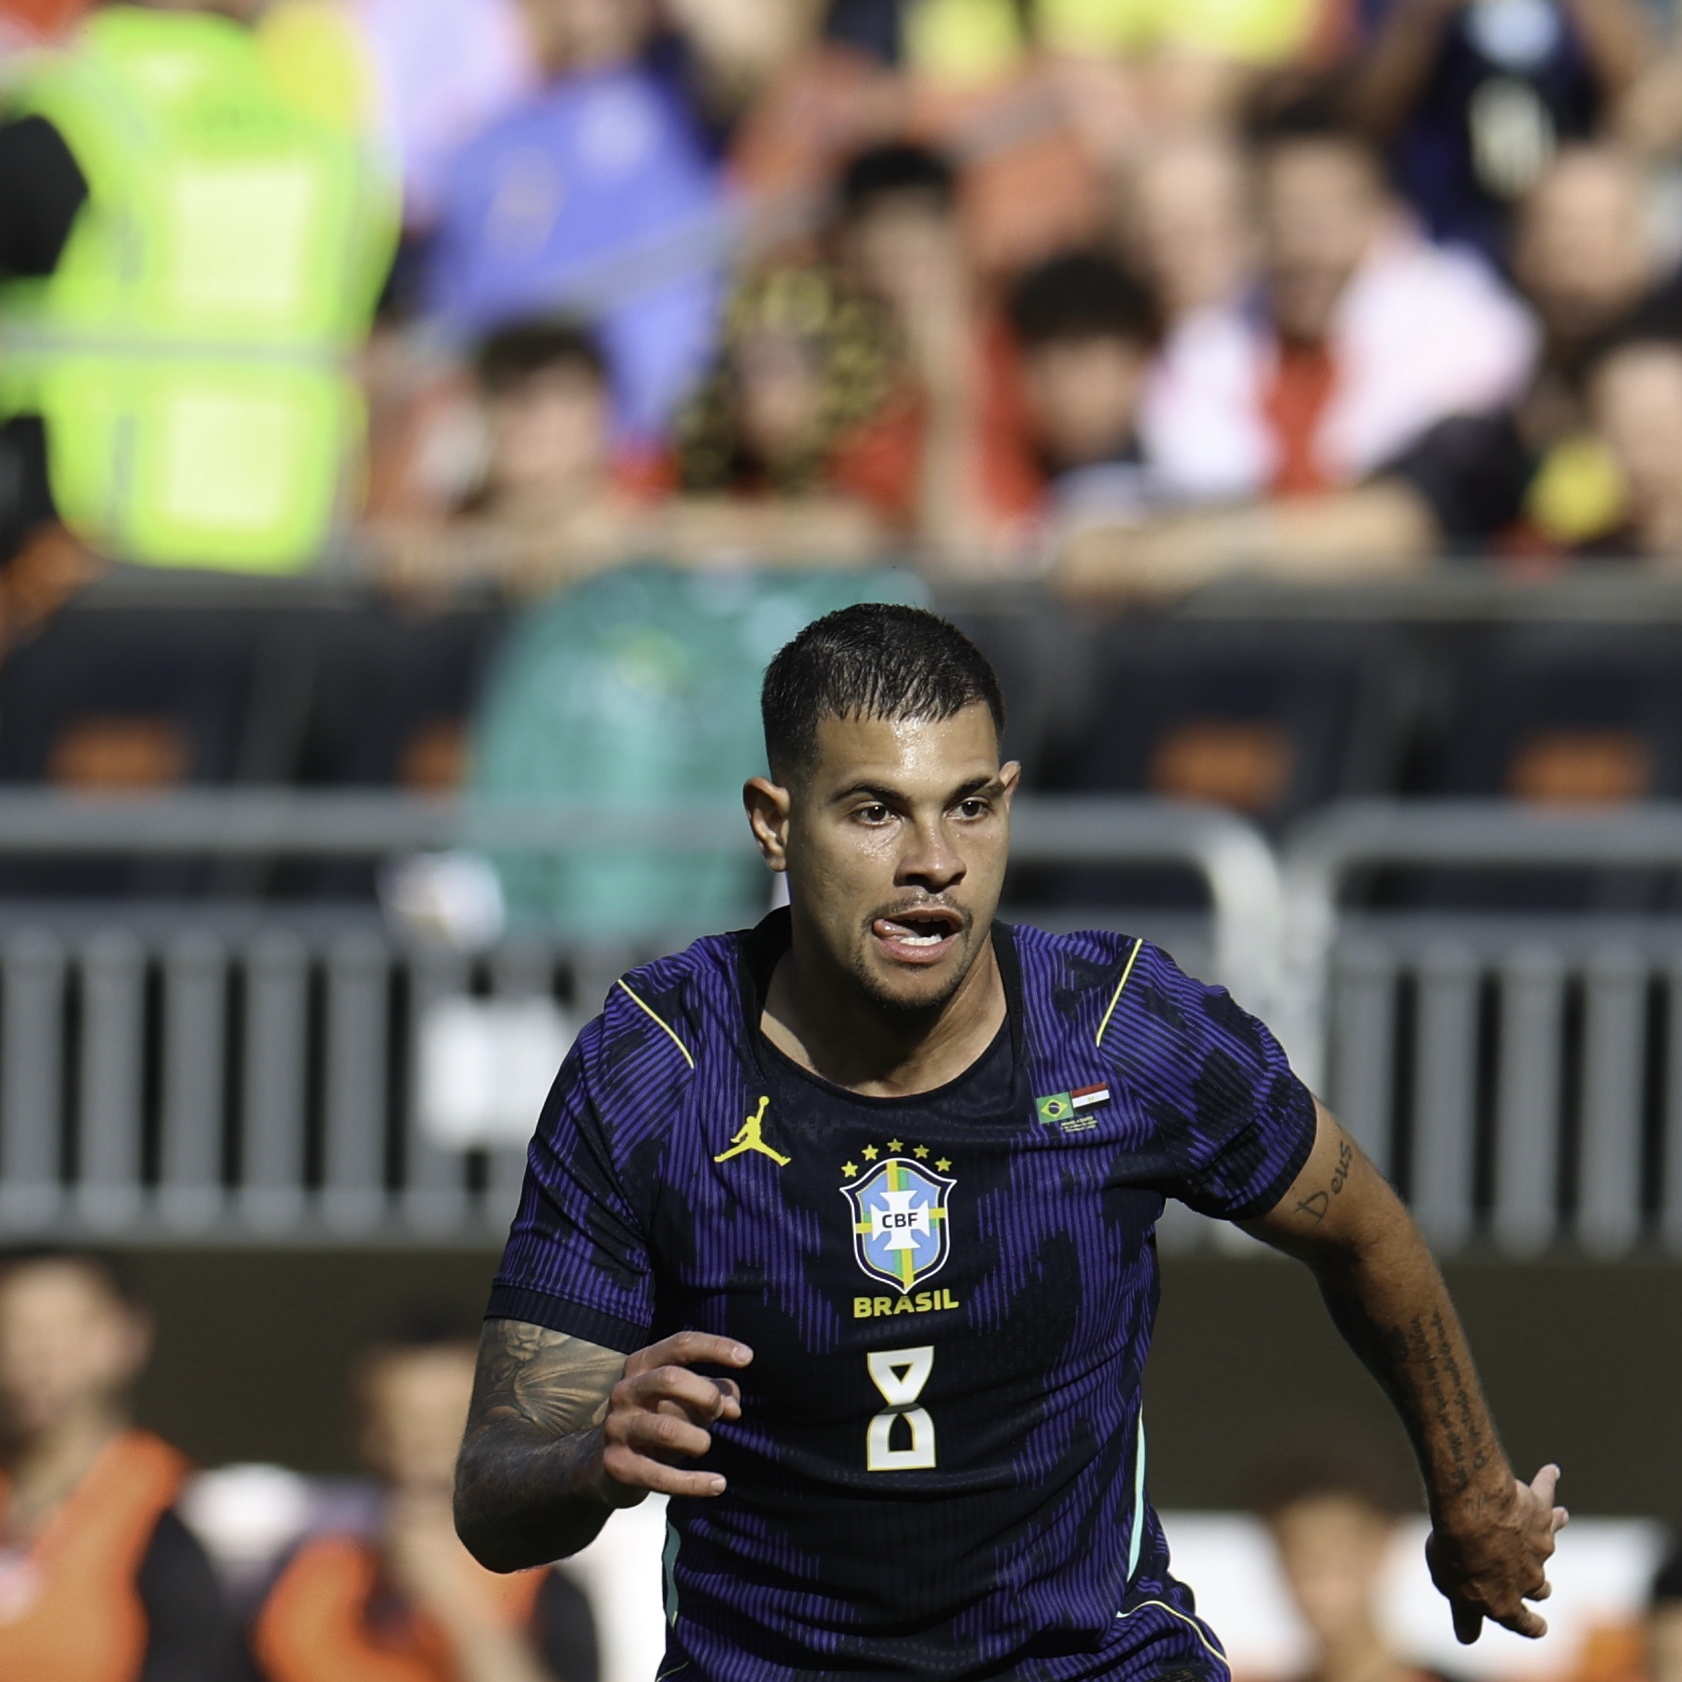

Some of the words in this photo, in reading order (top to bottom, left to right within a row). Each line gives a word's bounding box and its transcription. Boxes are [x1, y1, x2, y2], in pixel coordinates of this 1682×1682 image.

[1294, 1140, 1352, 1223] Deus
[882, 1212, 919, 1229] CBF
[853, 1288, 960, 1319] BRASIL
[866, 1345, 937, 1472] 8
